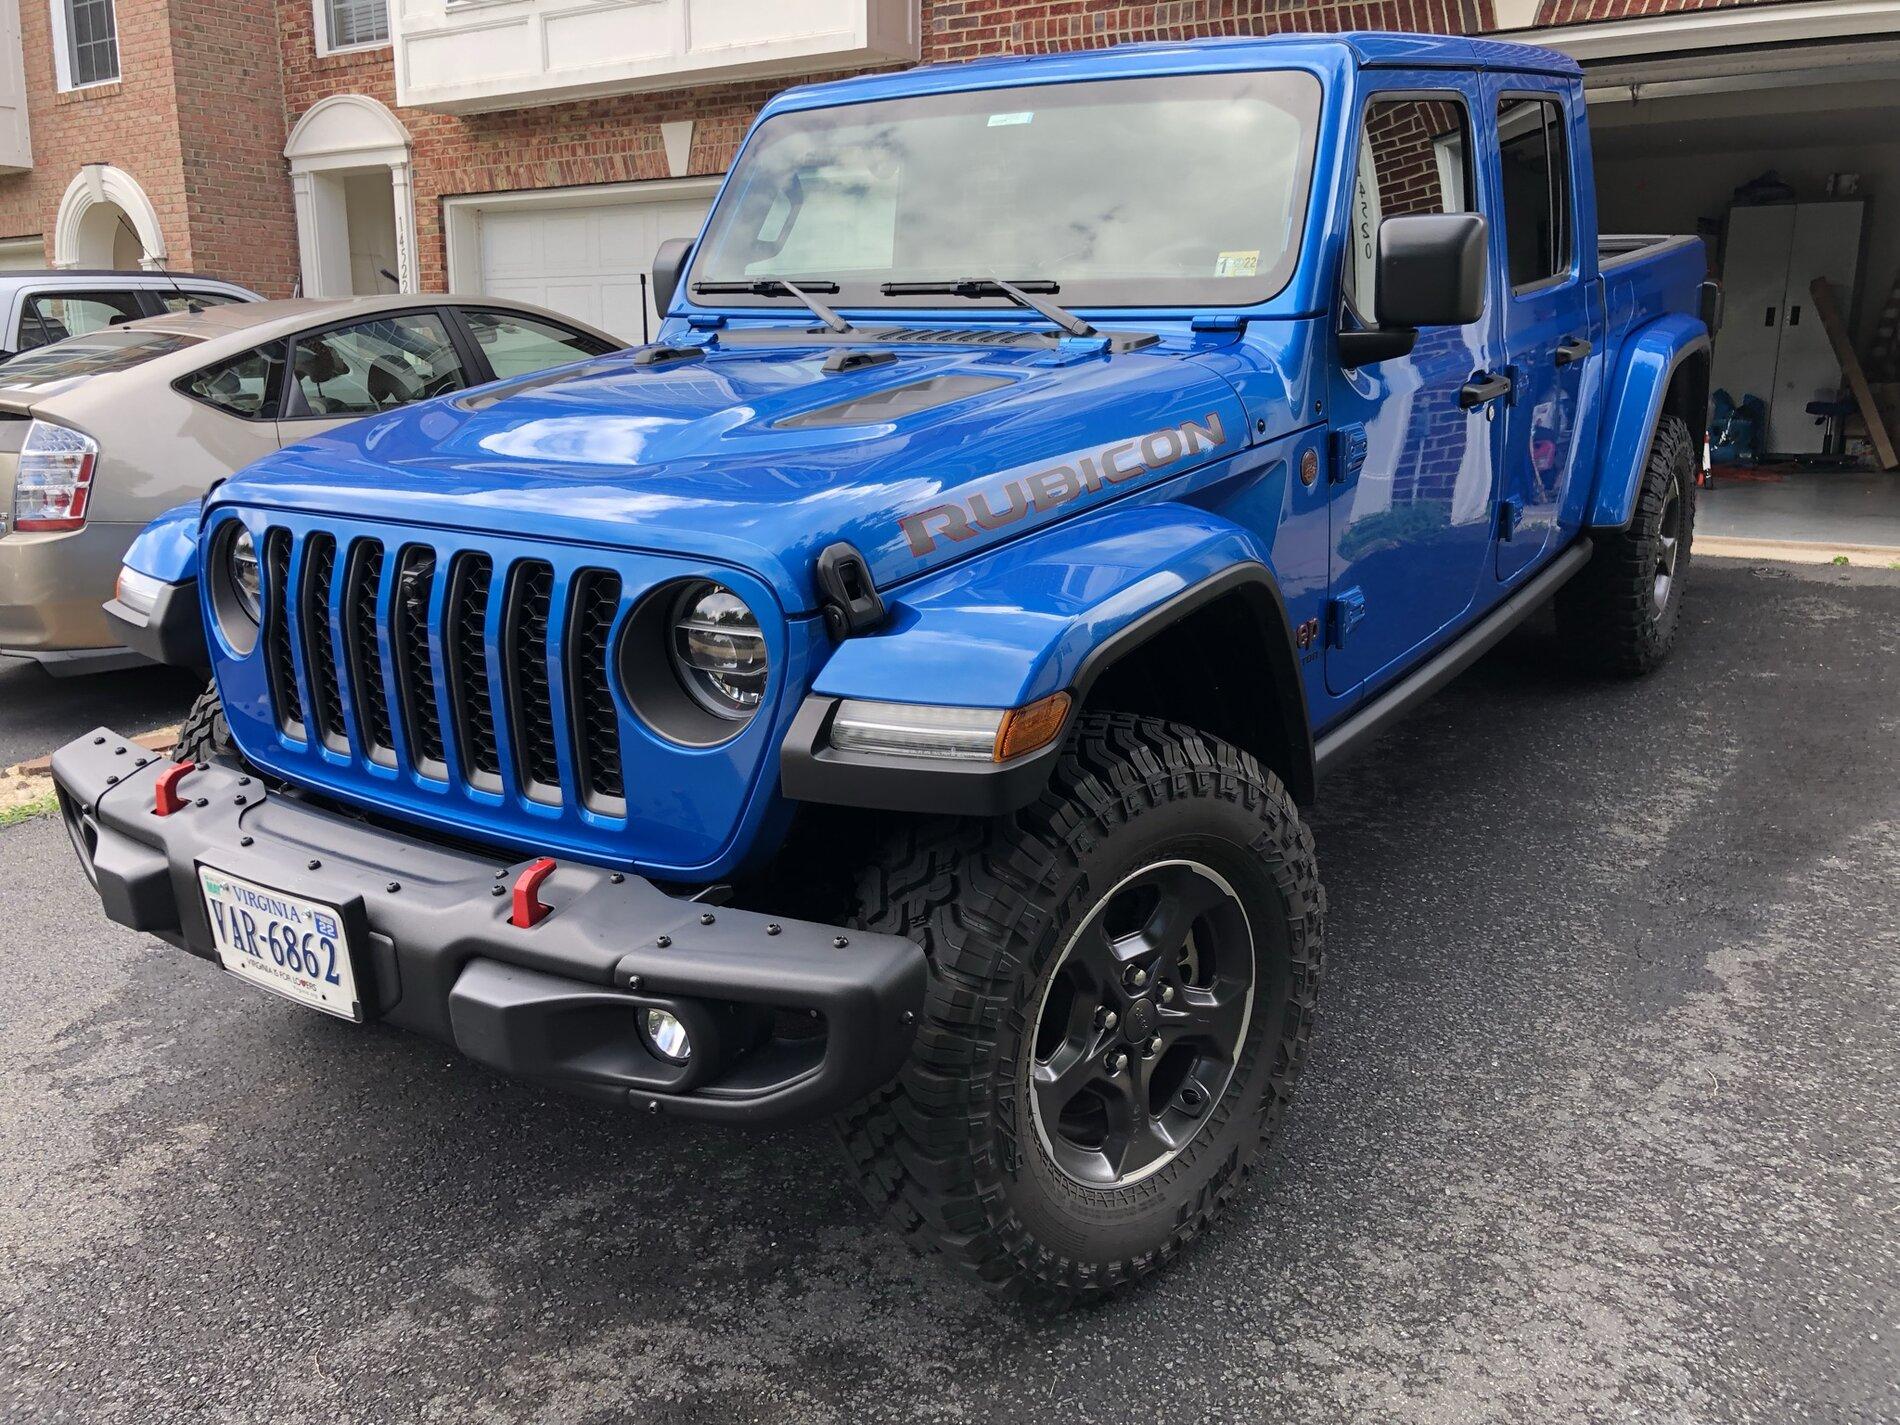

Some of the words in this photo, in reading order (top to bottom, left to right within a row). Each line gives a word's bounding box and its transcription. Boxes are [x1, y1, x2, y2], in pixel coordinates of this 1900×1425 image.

[398, 216, 409, 294] 14522
[1244, 256, 1257, 269] 22
[897, 411, 1226, 558] RUBICON
[232, 885, 302, 924] VIRGINIA
[318, 919, 336, 938] 22
[209, 897, 341, 986] VAR-6862
